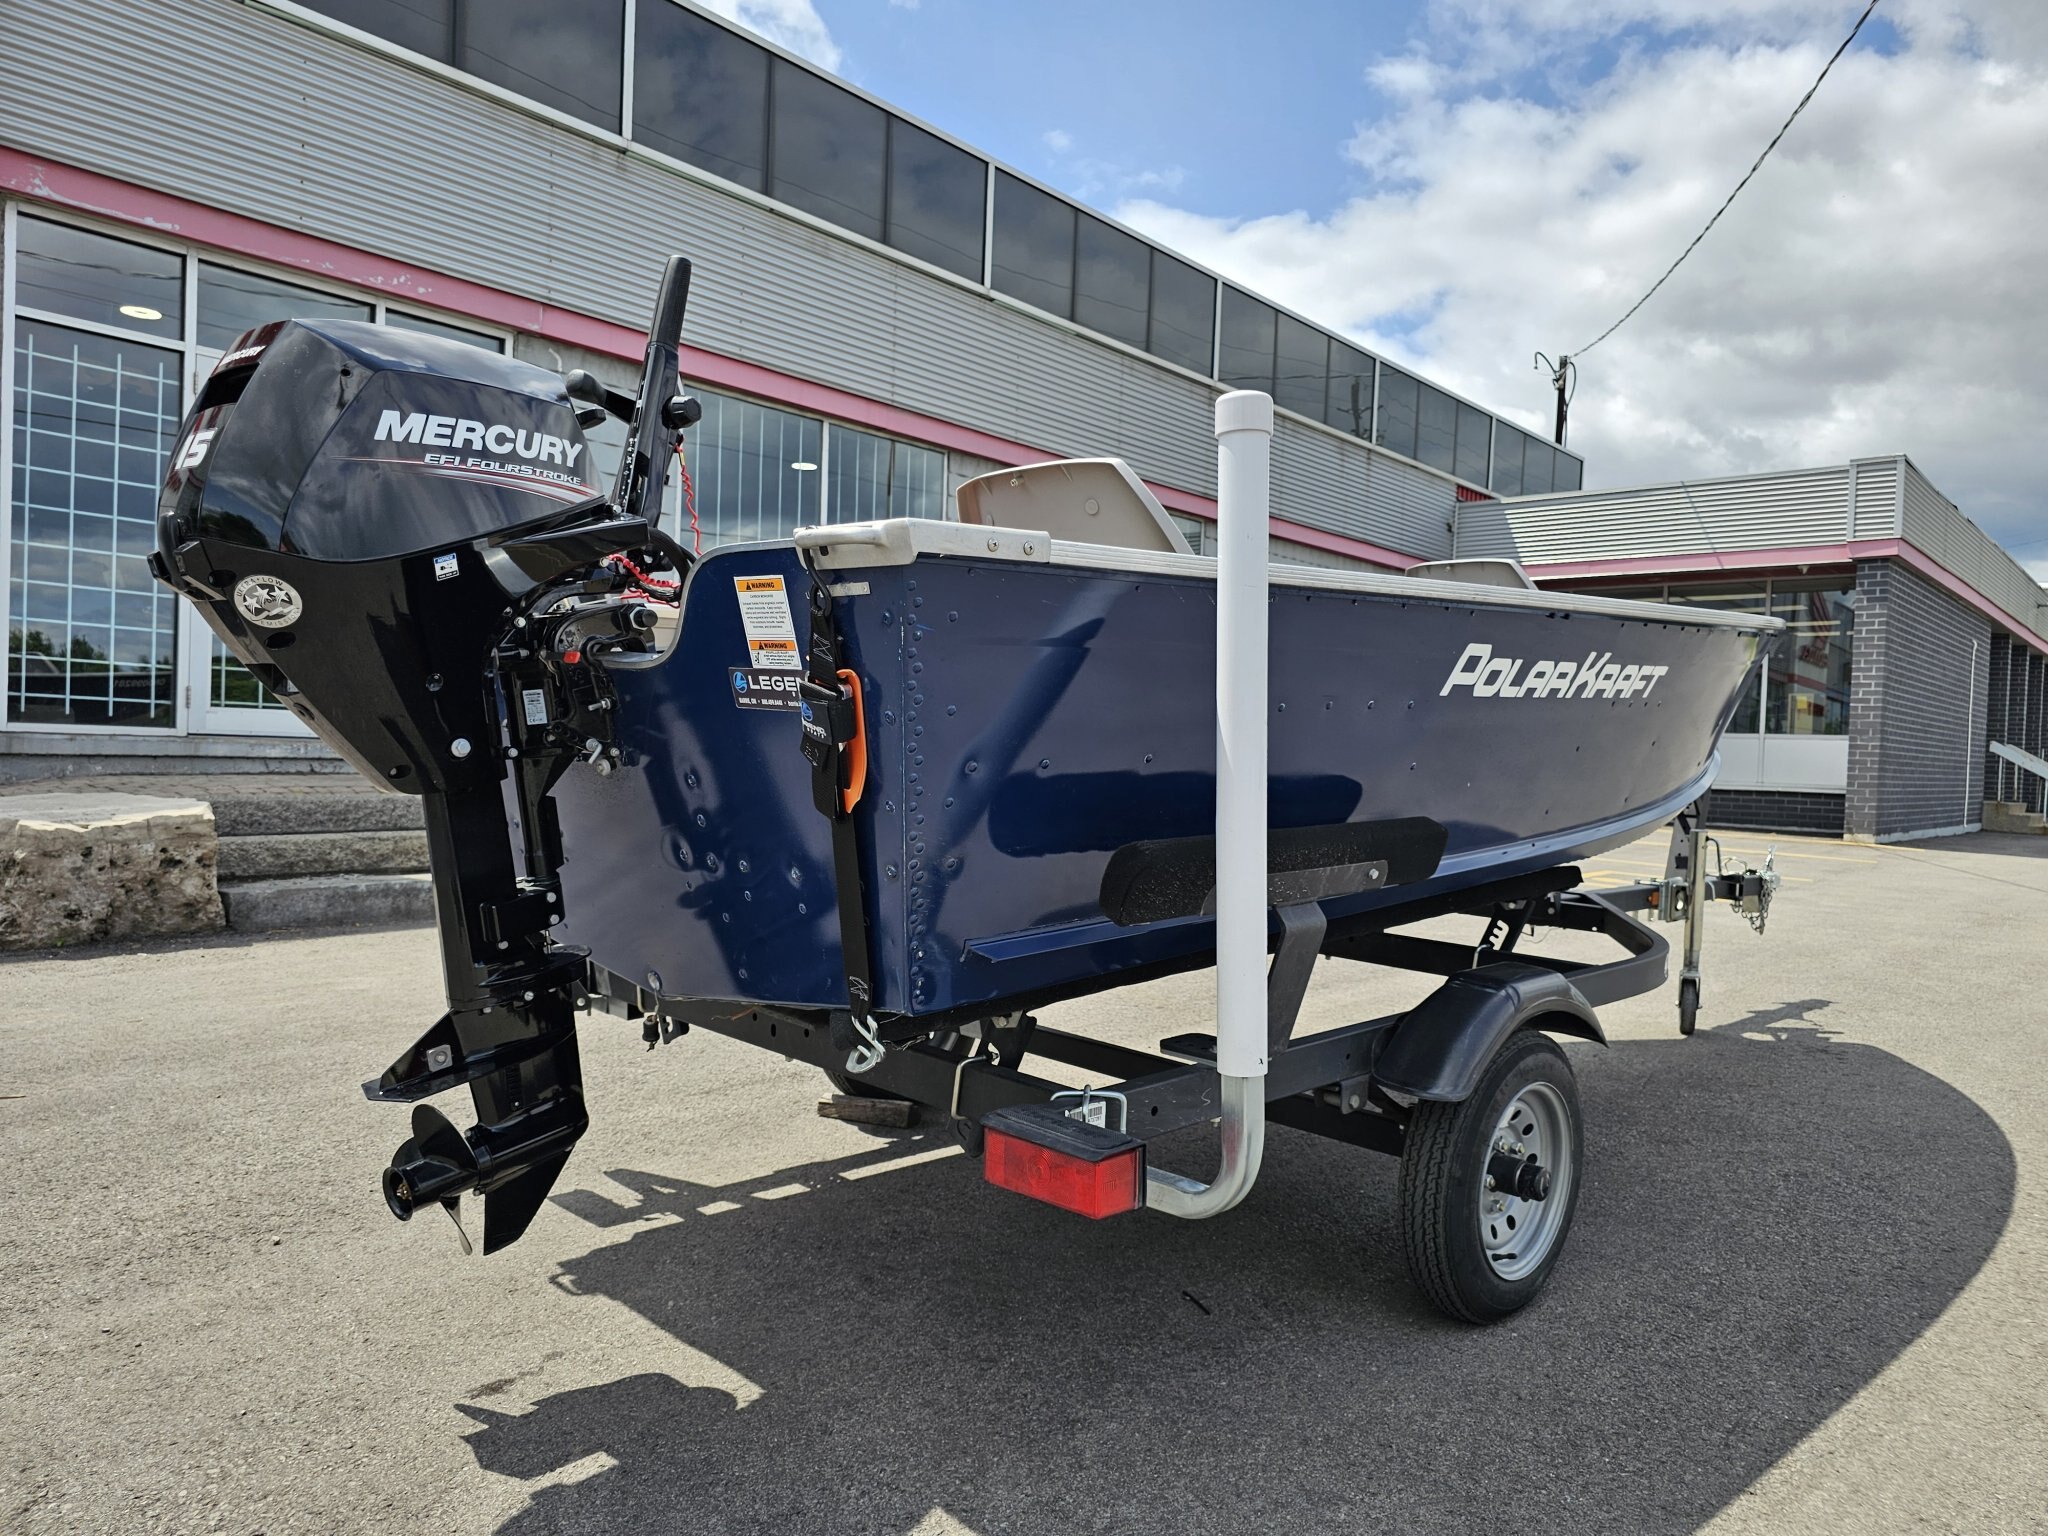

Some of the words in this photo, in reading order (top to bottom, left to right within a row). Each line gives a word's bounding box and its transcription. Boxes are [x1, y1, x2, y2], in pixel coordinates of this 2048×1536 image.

[373, 409, 584, 468] MERCURY
[174, 430, 217, 470] 15
[424, 453, 461, 466] EFI
[466, 457, 582, 485] FOURSTROKE
[262, 577, 284, 587] LOW
[751, 581, 775, 589] WARNING
[764, 642, 788, 650] WARNING
[748, 675, 801, 692] LEGE
